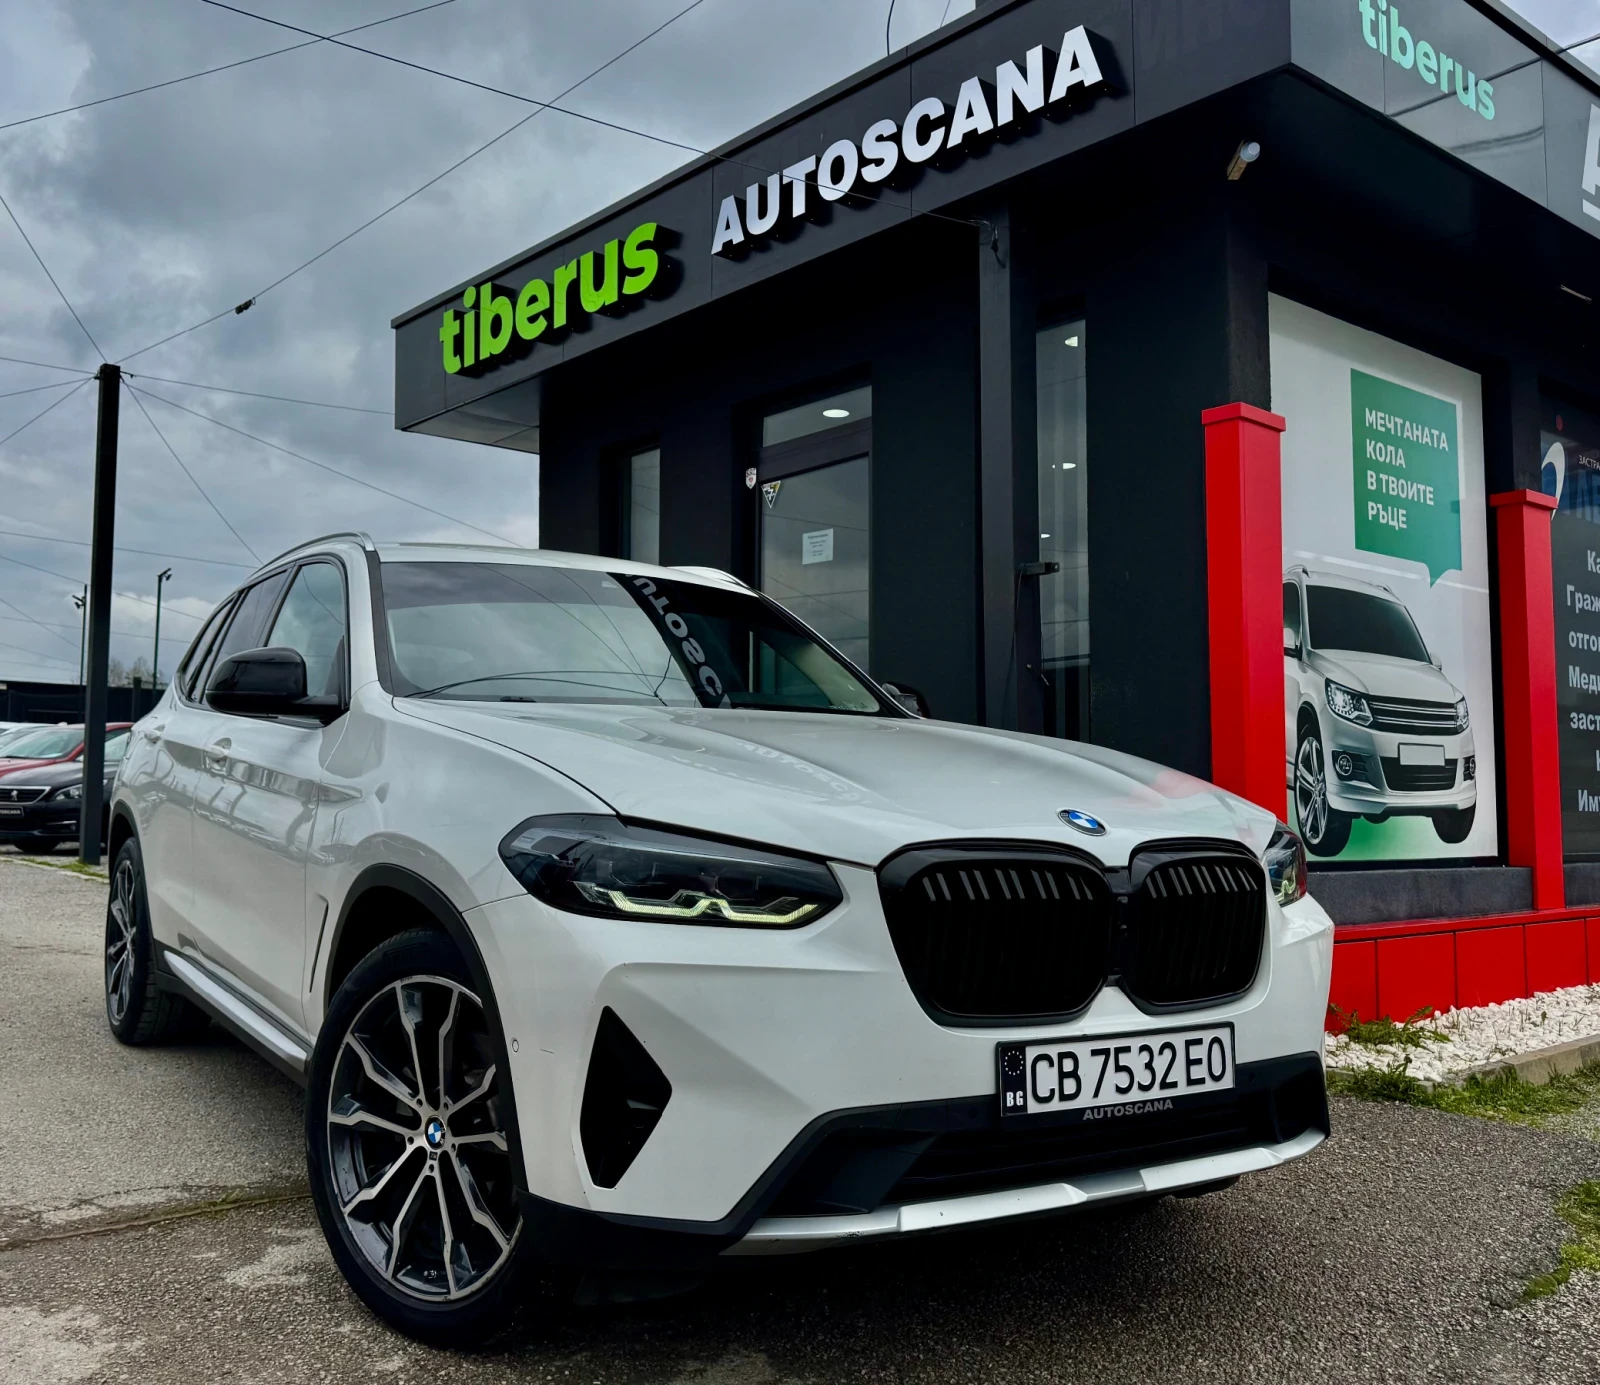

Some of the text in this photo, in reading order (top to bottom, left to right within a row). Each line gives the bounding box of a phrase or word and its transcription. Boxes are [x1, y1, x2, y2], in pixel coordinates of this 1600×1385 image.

[1358, 0, 1495, 120] tiberus
[711, 24, 1103, 255] AUTOSCANA
[439, 222, 658, 374] tiberus
[1365, 407, 1449, 452] МЕЧТАНАТА
[1366, 438, 1406, 468] КОЛА
[1367, 469, 1434, 506] В ТВОИТЕ
[1367, 501, 1407, 531] РЪЦЕ
[1568, 630, 1600, 652] отго
[1030, 1050, 1082, 1104] CB
[1090, 1041, 1178, 1099] 7532
[1006, 1090, 1024, 1107] BG
[1082, 1099, 1173, 1120] AUTOSCANA
